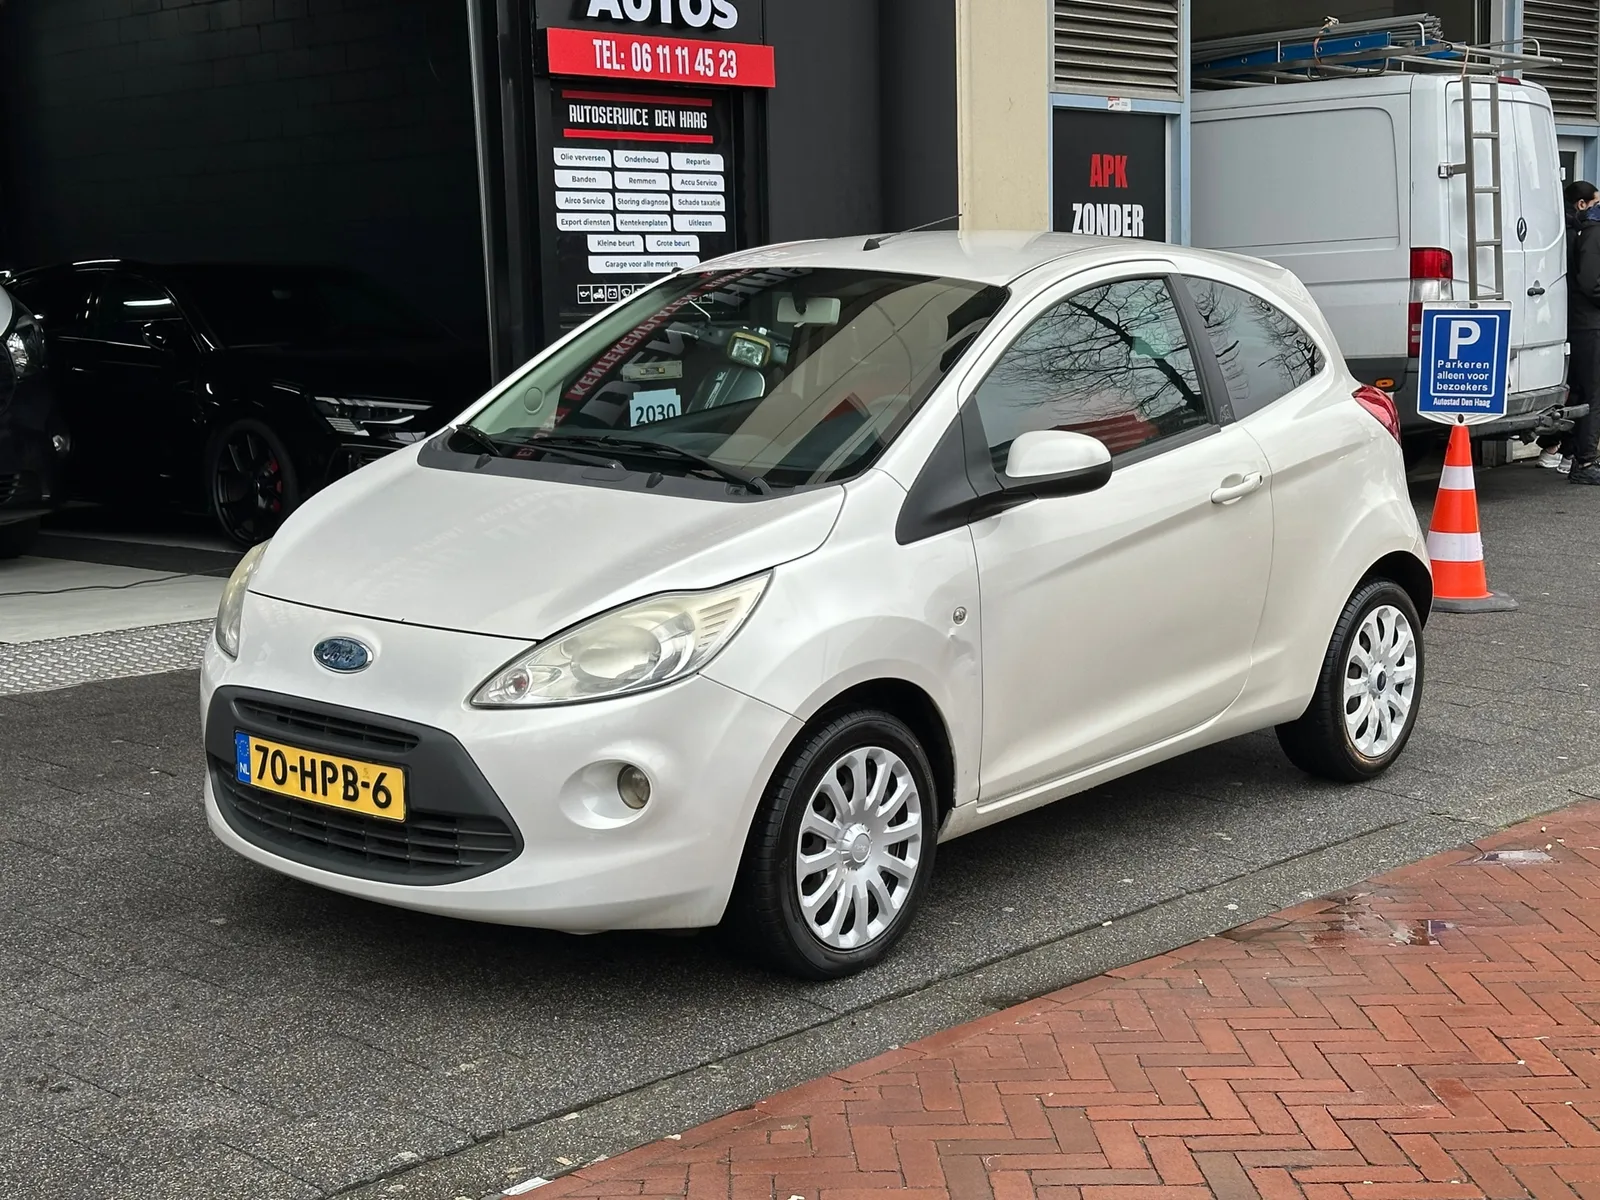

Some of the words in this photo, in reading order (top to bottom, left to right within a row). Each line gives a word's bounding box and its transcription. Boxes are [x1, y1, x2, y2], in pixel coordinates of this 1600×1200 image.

[586, 0, 739, 30] AUTOS
[592, 38, 626, 71] TEL:
[631, 41, 652, 73] 06
[656, 44, 671, 74] 11
[675, 46, 690, 76] 11
[694, 47, 715, 78] 45
[718, 49, 738, 79] 23
[568, 104, 649, 126] AUTOSERVICE
[654, 109, 676, 128] DEN
[679, 111, 708, 130] HAAG
[560, 153, 574, 161] Olie
[575, 154, 606, 162] verversen
[624, 155, 659, 164] Onderhoud
[685, 158, 711, 167] Repartie
[1089, 153, 1129, 188] APK
[571, 175, 597, 183] Banden
[628, 177, 657, 185] Remmen
[680, 178, 695, 186] Accu
[696, 179, 718, 187] Service
[564, 197, 582, 205] Airco
[582, 197, 606, 205] Service
[617, 197, 640, 206] Storing
[641, 198, 669, 207] diagnose
[678, 198, 700, 206] Schade
[701, 199, 721, 207] taxatie
[560, 218, 582, 228] Export
[583, 218, 611, 227] diensten
[619, 219, 668, 228] Kentekenplaten
[688, 219, 713, 227] Uitlezen
[1072, 202, 1145, 237] ZONDER
[597, 239, 618, 247] Kleine
[618, 239, 636, 247] beurt
[604, 260, 628, 269] Garage
[655, 260, 678, 268] merken
[1449, 320, 1481, 360] P
[1437, 360, 1490, 369] Parkeren
[1436, 371, 1465, 380] alleen
[1436, 381, 1489, 391] bezoekers
[1433, 397, 1460, 406] Autostad
[1461, 398, 1473, 407] Den
[1474, 398, 1491, 408] Haag
[634, 402, 677, 425] 2030
[239, 761, 250, 775] NL
[254, 744, 393, 809] 70-HPB-6
